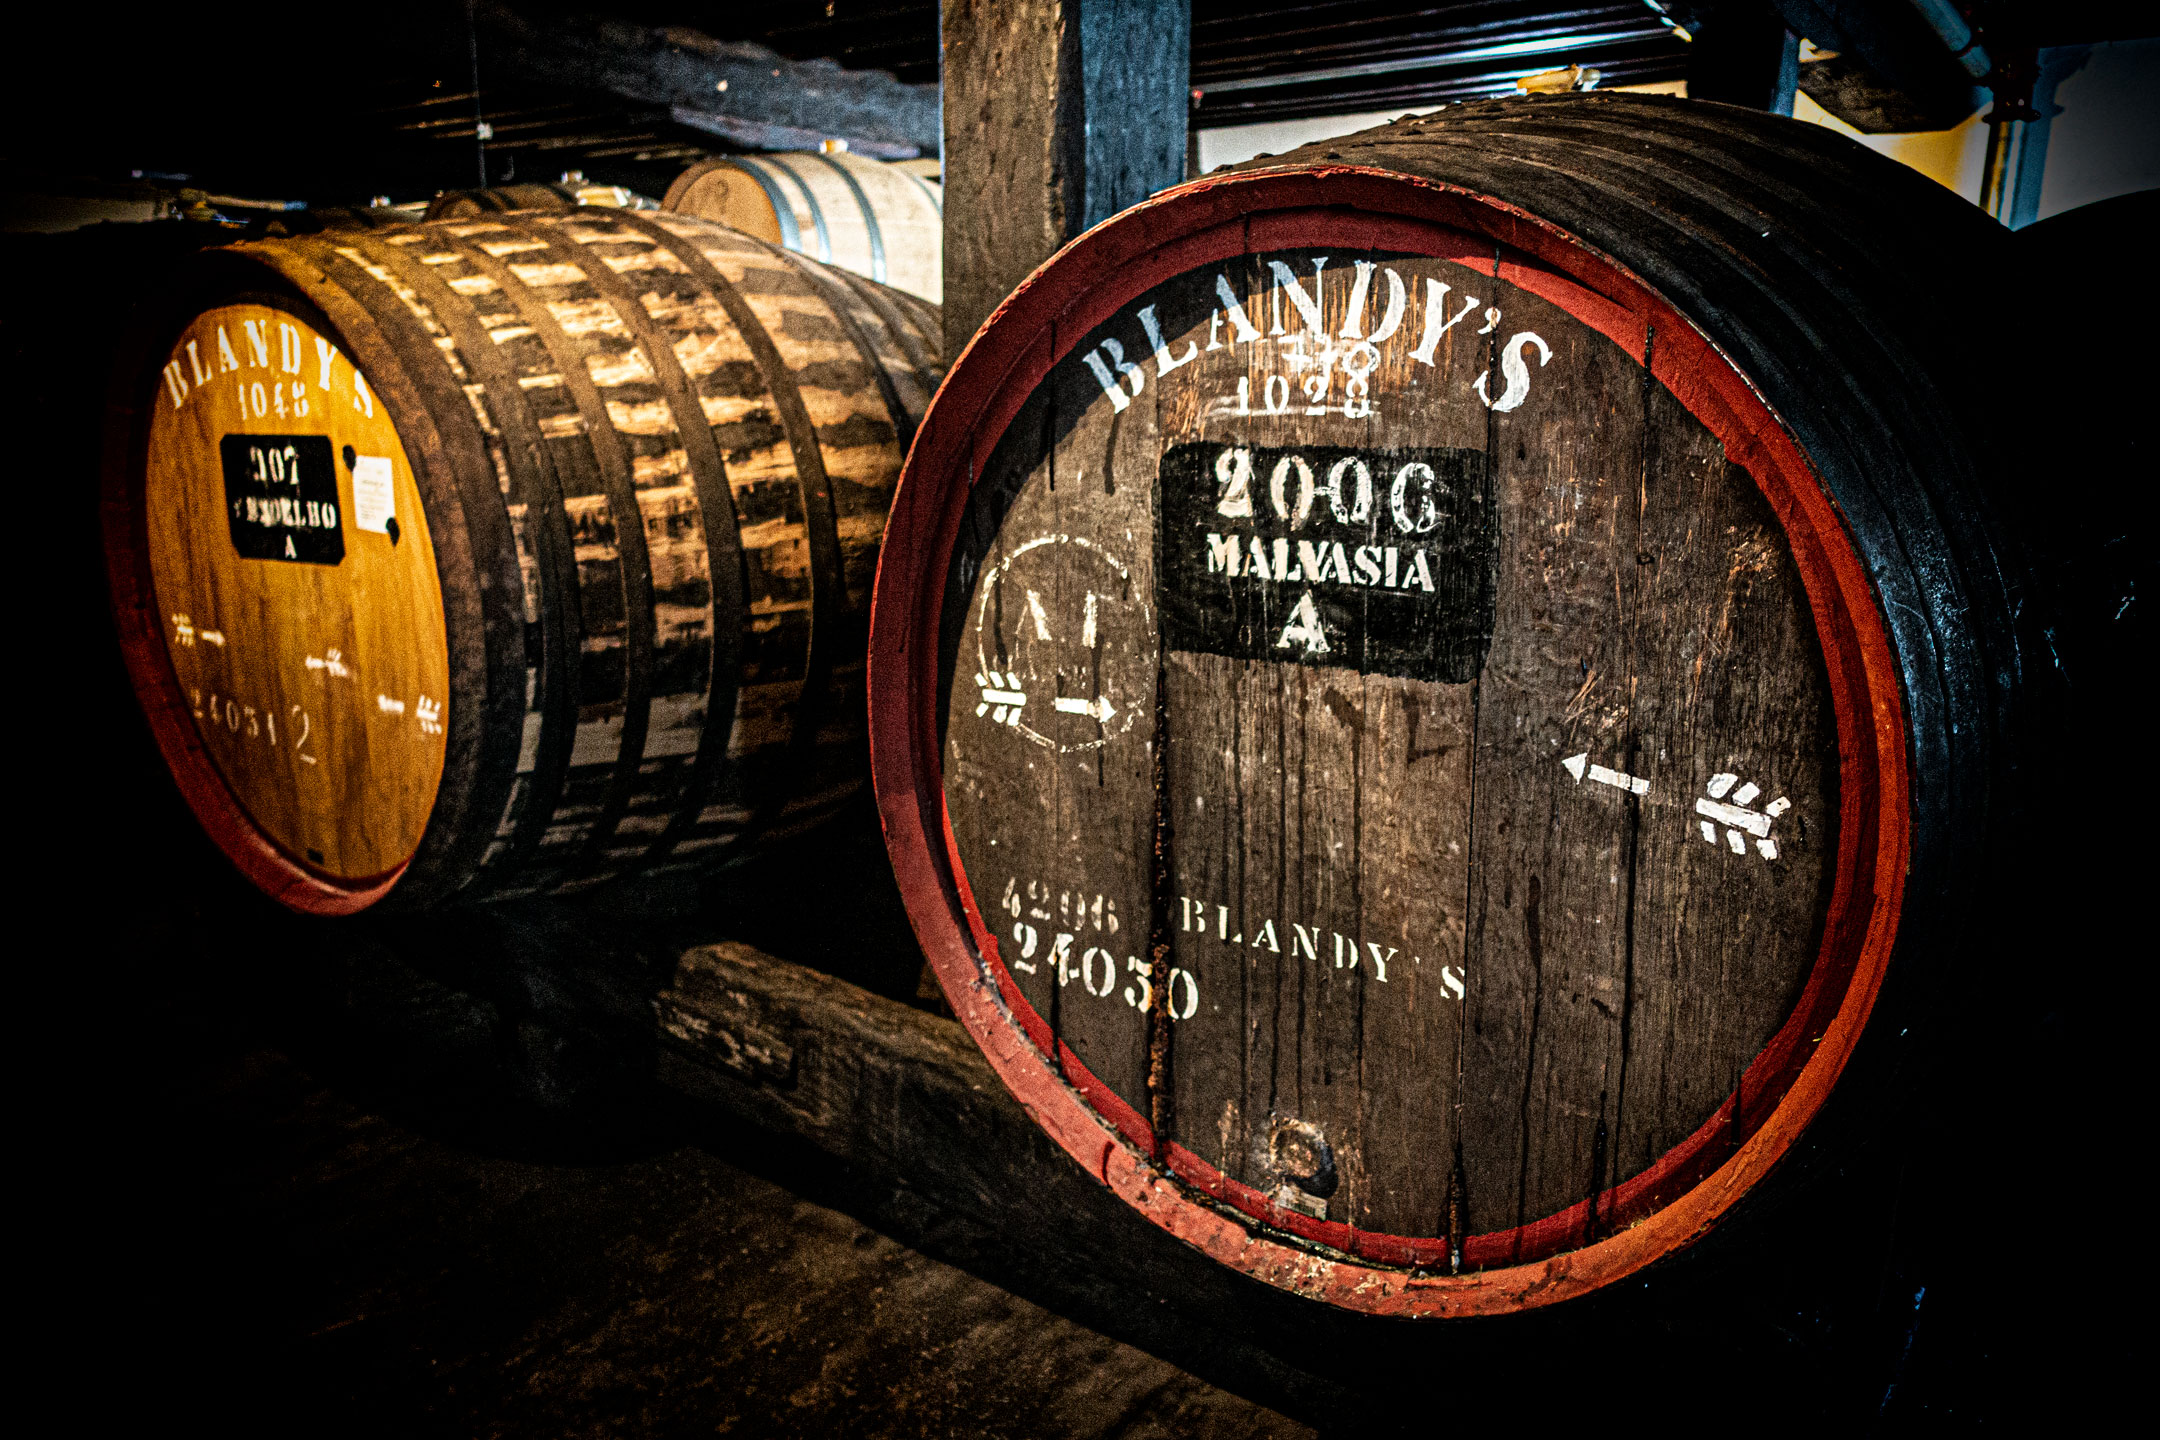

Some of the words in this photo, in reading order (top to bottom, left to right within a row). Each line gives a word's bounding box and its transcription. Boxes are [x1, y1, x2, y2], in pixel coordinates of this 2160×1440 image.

[1082, 255, 1553, 414] BLANDY'S
[162, 319, 374, 419] BLANDYS
[1235, 373, 1370, 419] 1028
[1206, 532, 1436, 593] MALVASIA
[1276, 589, 1331, 653] A
